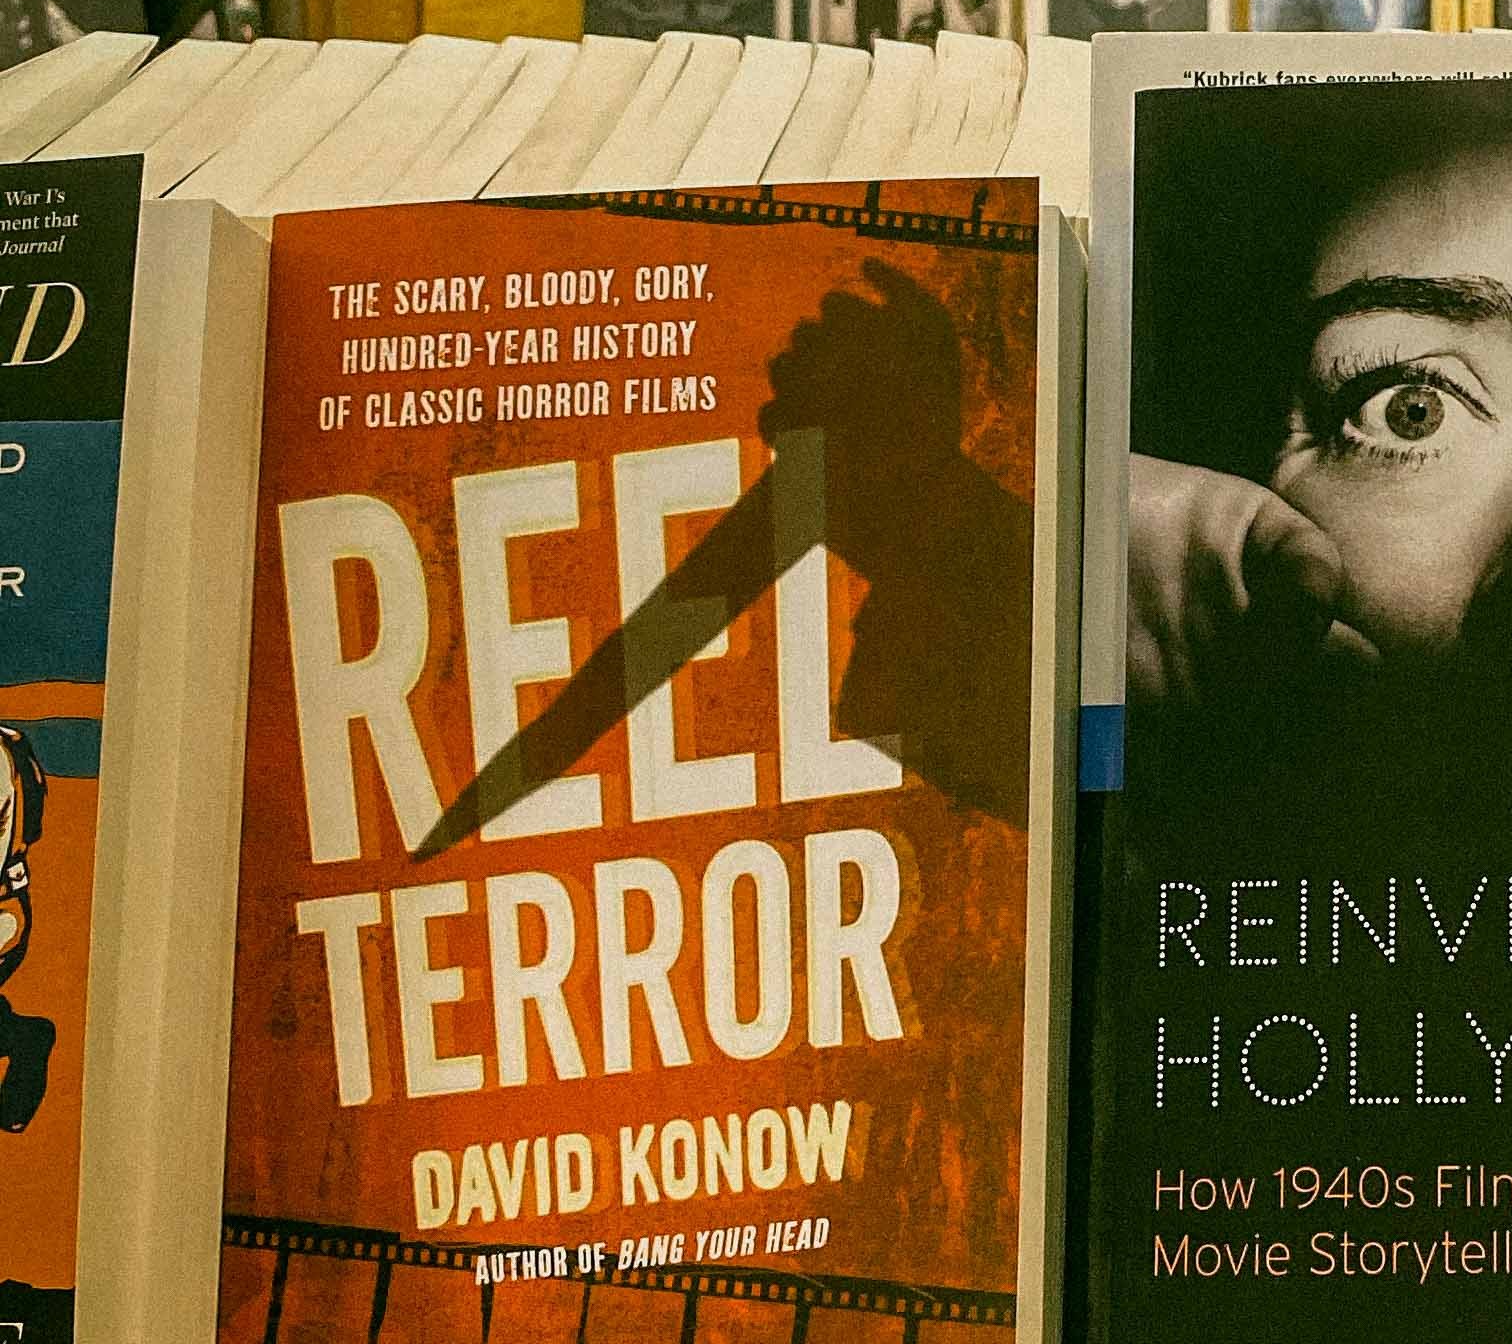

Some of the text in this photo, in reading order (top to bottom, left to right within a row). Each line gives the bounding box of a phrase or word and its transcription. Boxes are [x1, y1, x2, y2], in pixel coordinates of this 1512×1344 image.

[4, 190, 41, 207] War
[44, 211, 80, 229] that
[0, 234, 66, 256] Journal
[329, 262, 715, 320] THE SCARY, BLOODY, GORY,
[341, 321, 697, 375] HUNDRED-YEAR HISTORY
[319, 376, 718, 432] OF CLASSIC HORROR FILMS
[278, 438, 903, 863] REEL
[295, 827, 905, 1109] TERROR
[411, 1099, 853, 1230] DAVID KONOW
[1154, 1167, 1256, 1212] How
[1271, 1164, 1416, 1212] 1940s
[475, 1217, 831, 1285] AUTHOR OF BANG YOUR HEAD
[1153, 1230, 1292, 1279] Movie
